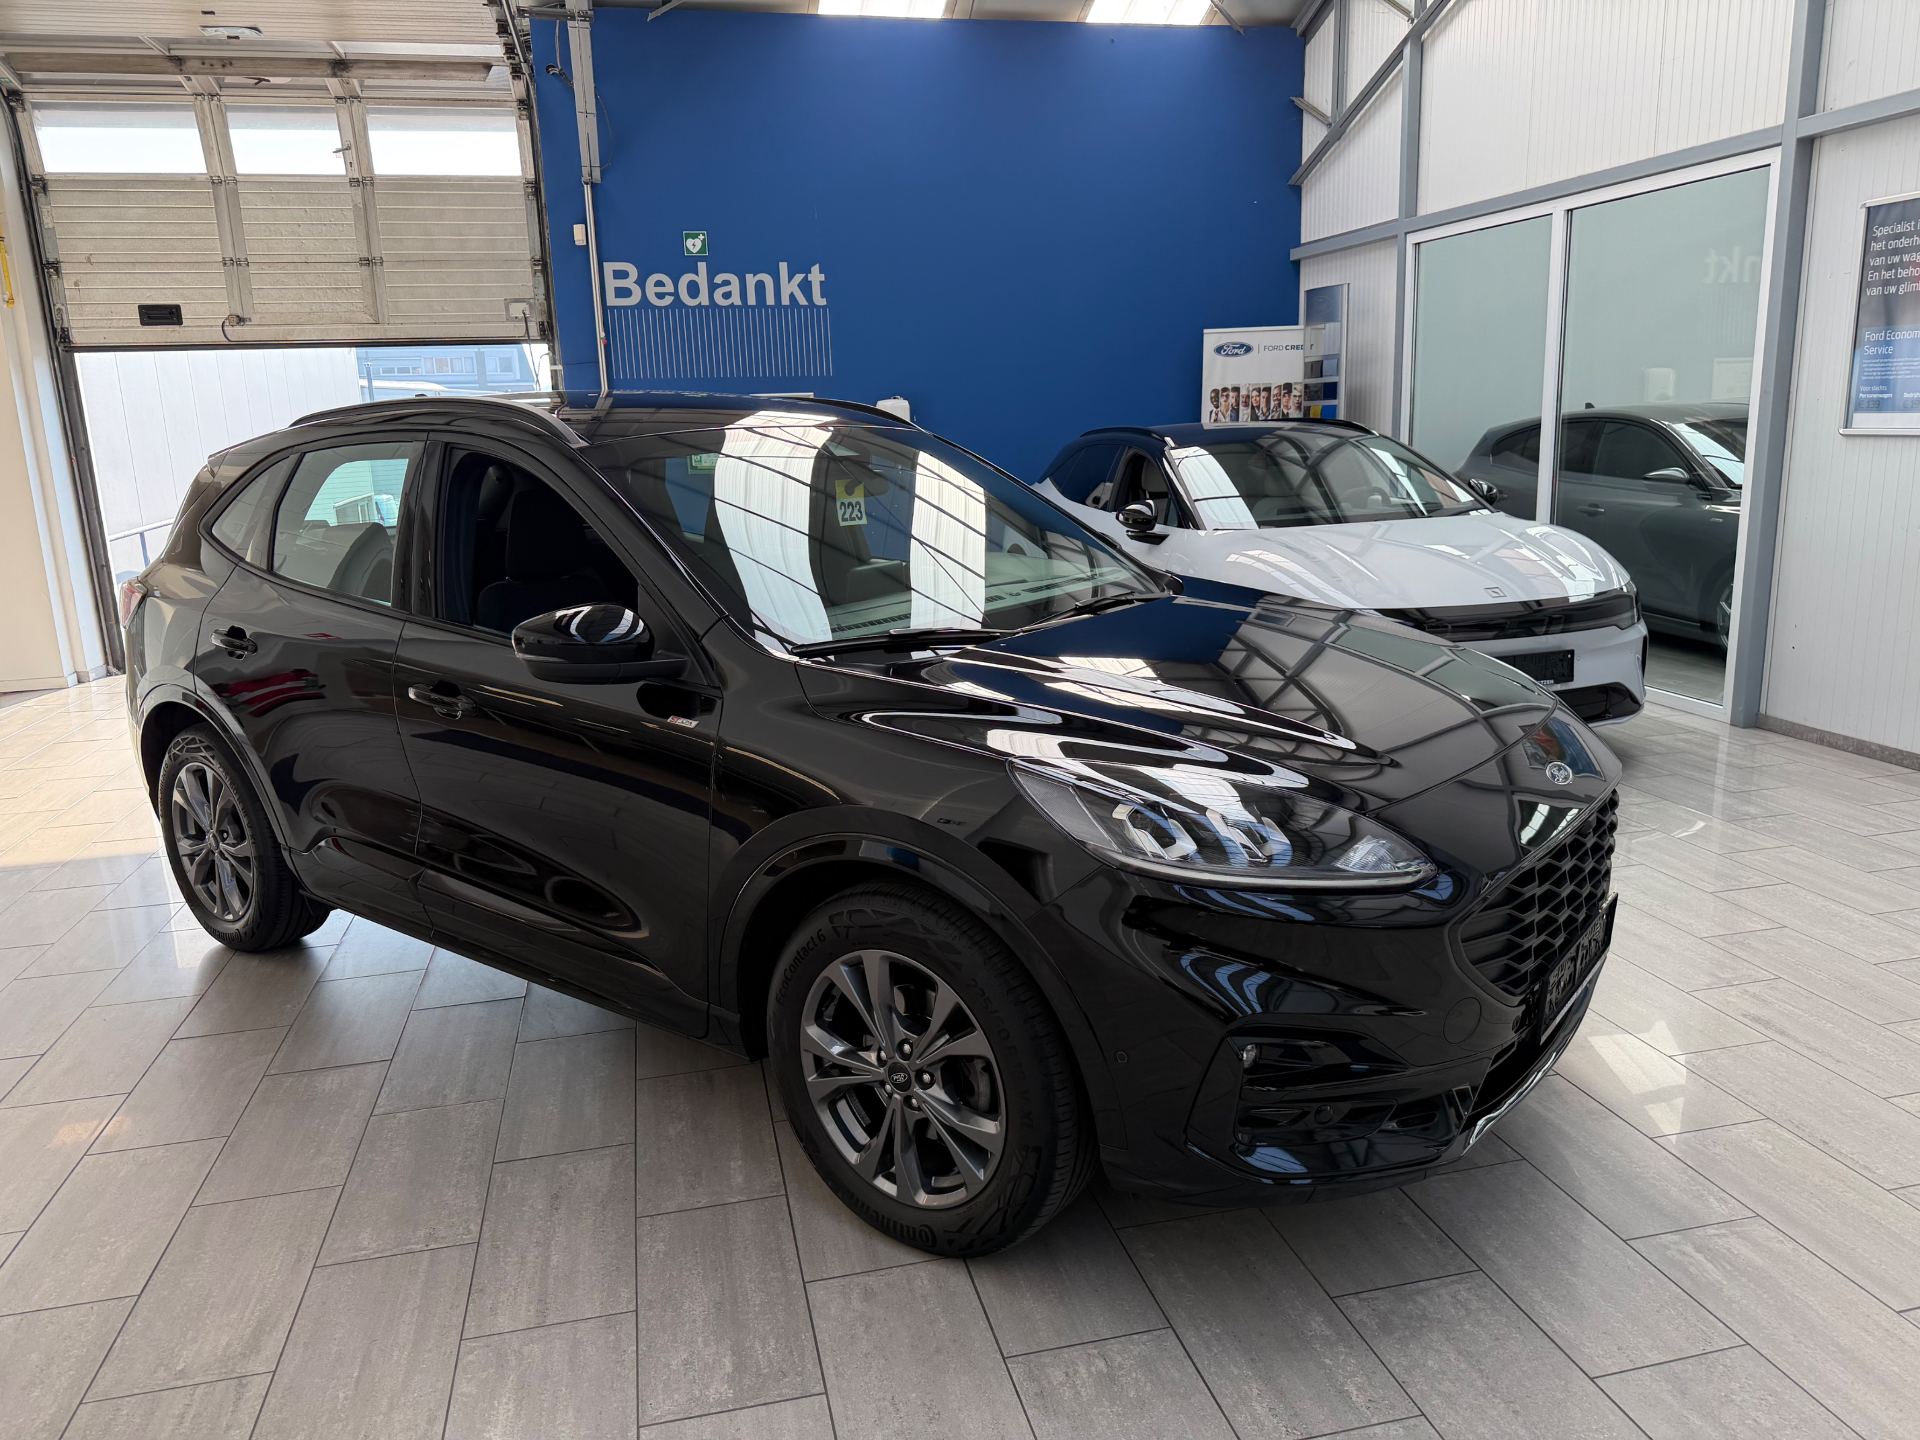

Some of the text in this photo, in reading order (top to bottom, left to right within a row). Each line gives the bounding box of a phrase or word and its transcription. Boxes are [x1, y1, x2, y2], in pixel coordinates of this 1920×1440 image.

[1872, 220, 1915, 237] Specialist
[1870, 241, 1886, 252] het
[1869, 256, 1885, 267] van
[1887, 254, 1901, 265] uw
[1867, 270, 1879, 282] En
[1881, 268, 1896, 280] het
[603, 262, 827, 306] Bedankt
[1866, 286, 1882, 296] van
[1884, 284, 1898, 295] uw
[1864, 330, 1885, 342] Ford
[1263, 344, 1284, 352] FORD
[1863, 344, 1894, 356] Service
[839, 500, 864, 522] 223
[775, 928, 826, 1007] EcoContact 6
